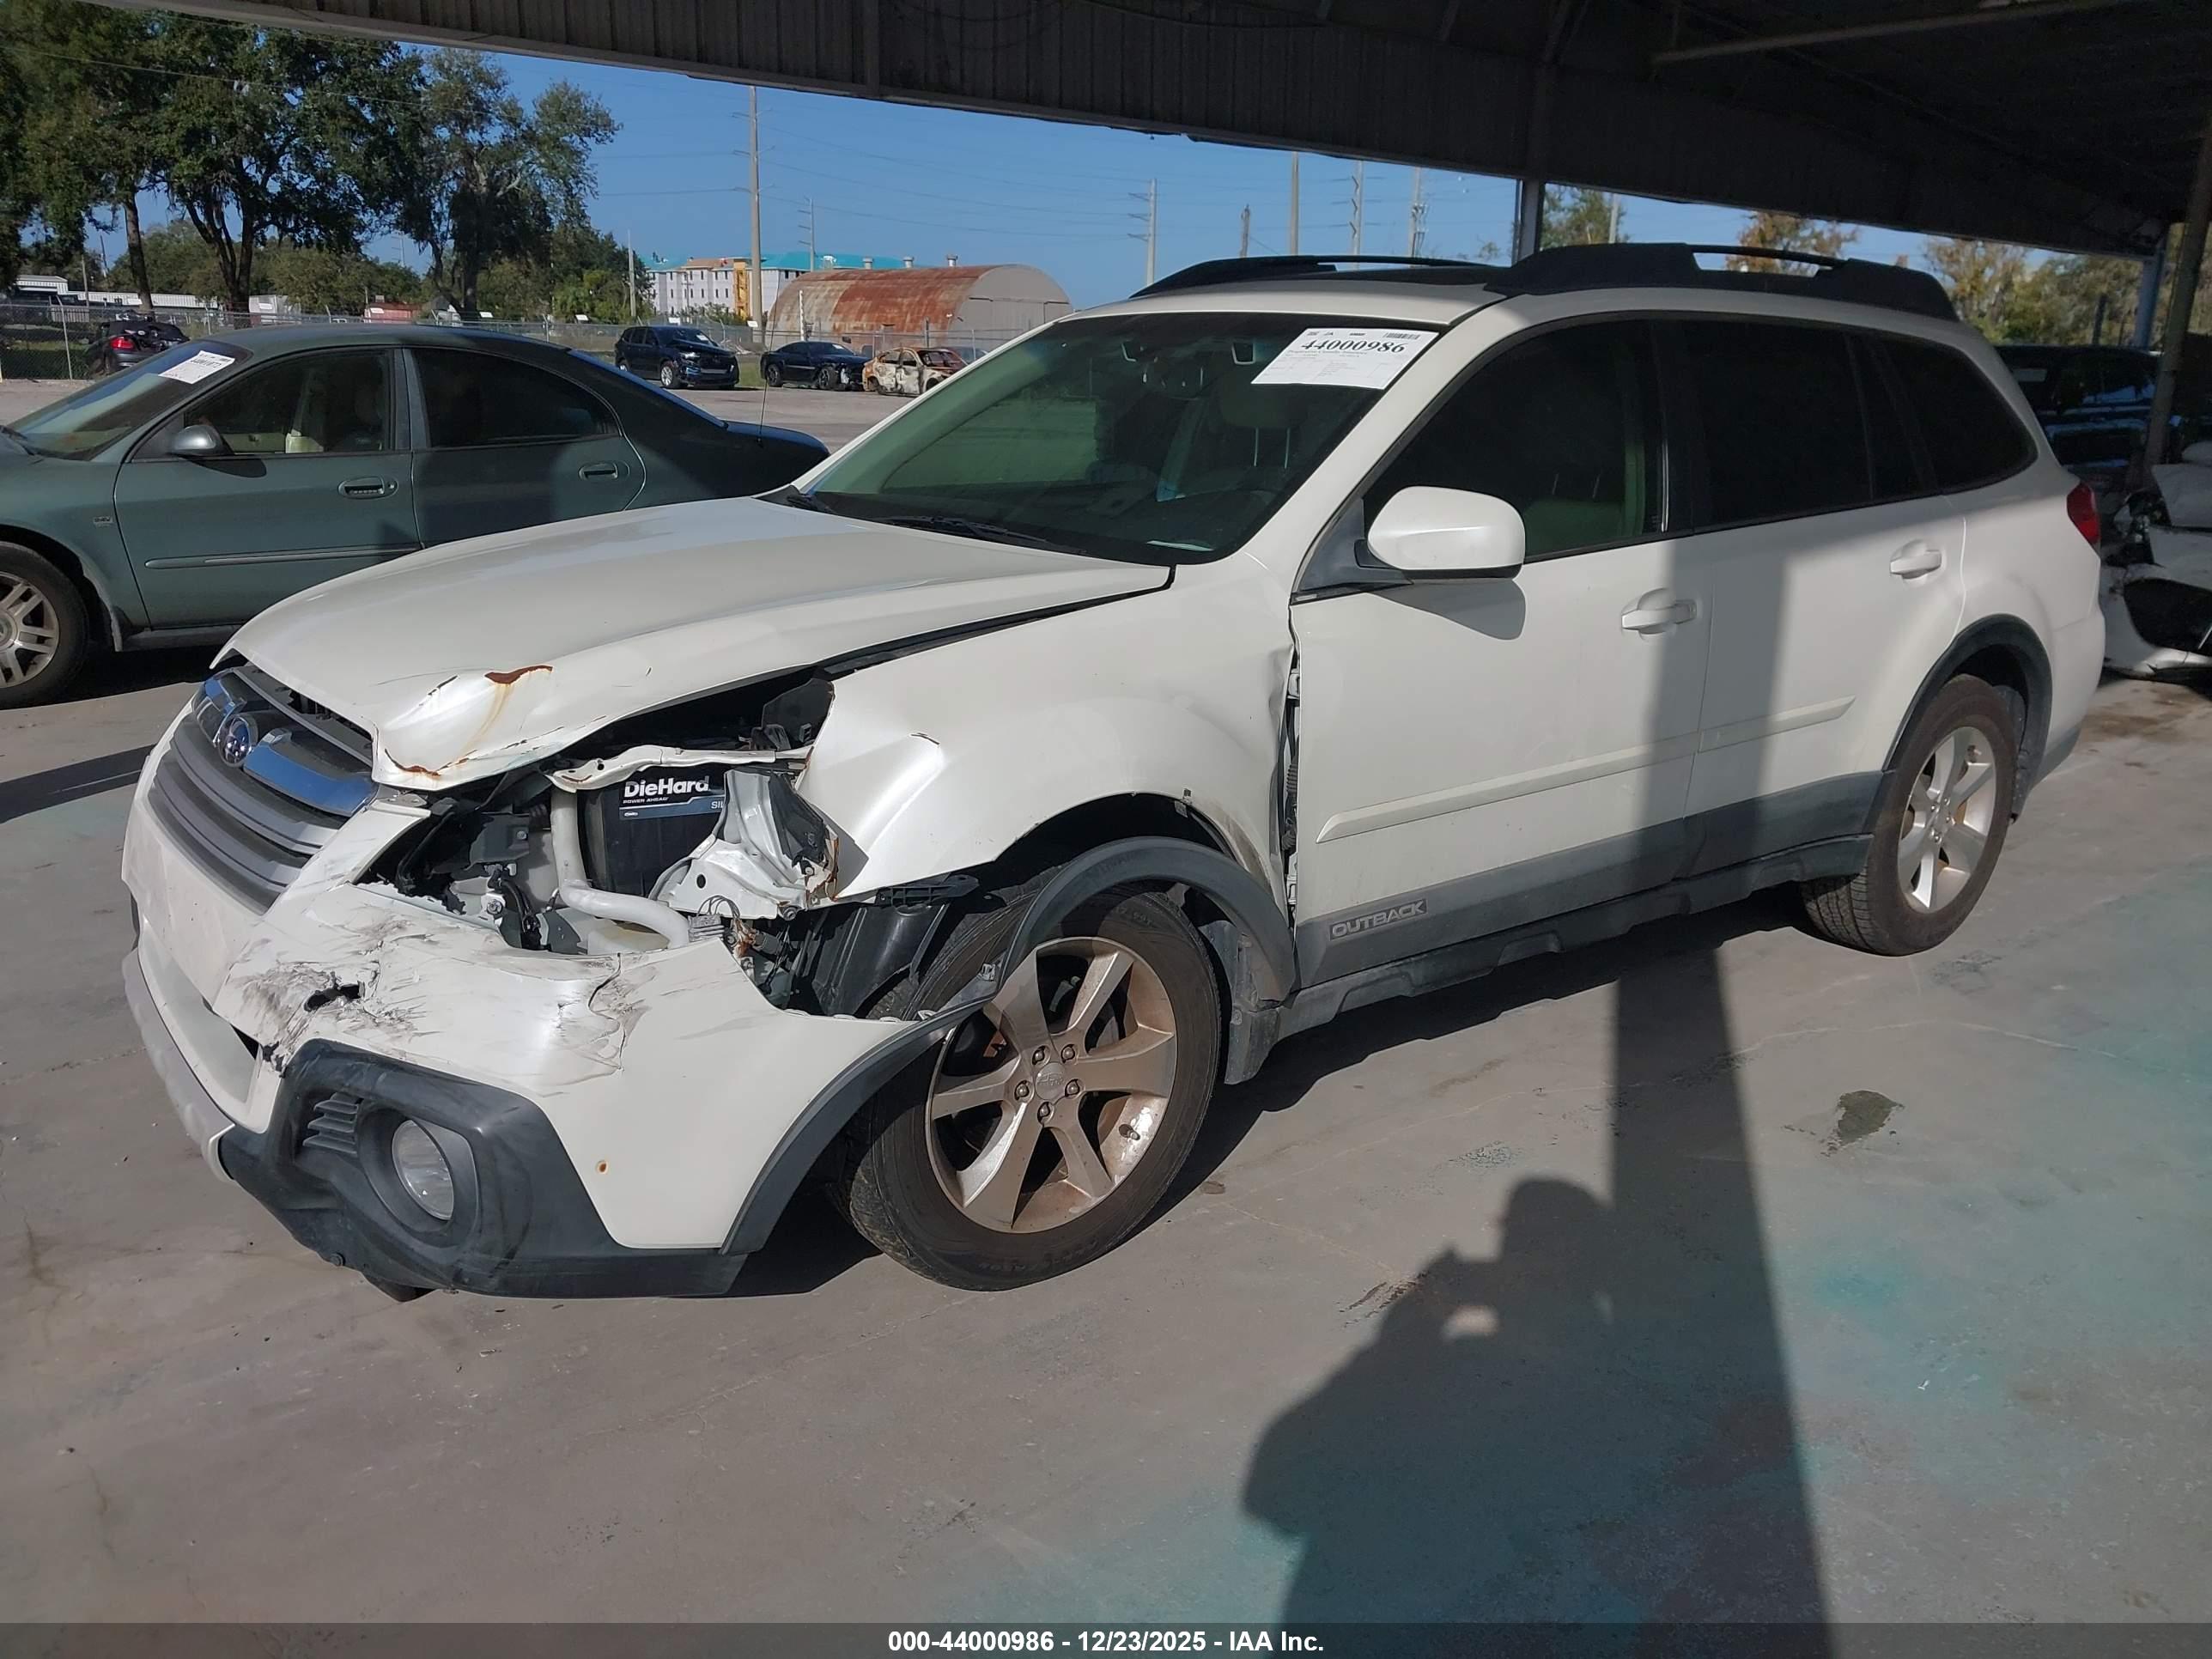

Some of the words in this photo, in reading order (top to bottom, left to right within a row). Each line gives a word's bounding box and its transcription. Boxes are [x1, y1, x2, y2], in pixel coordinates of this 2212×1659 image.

[1301, 339, 1407, 353] 44000986
[624, 775, 709, 798] DieHard
[1332, 900, 1425, 937] OUTBACK
